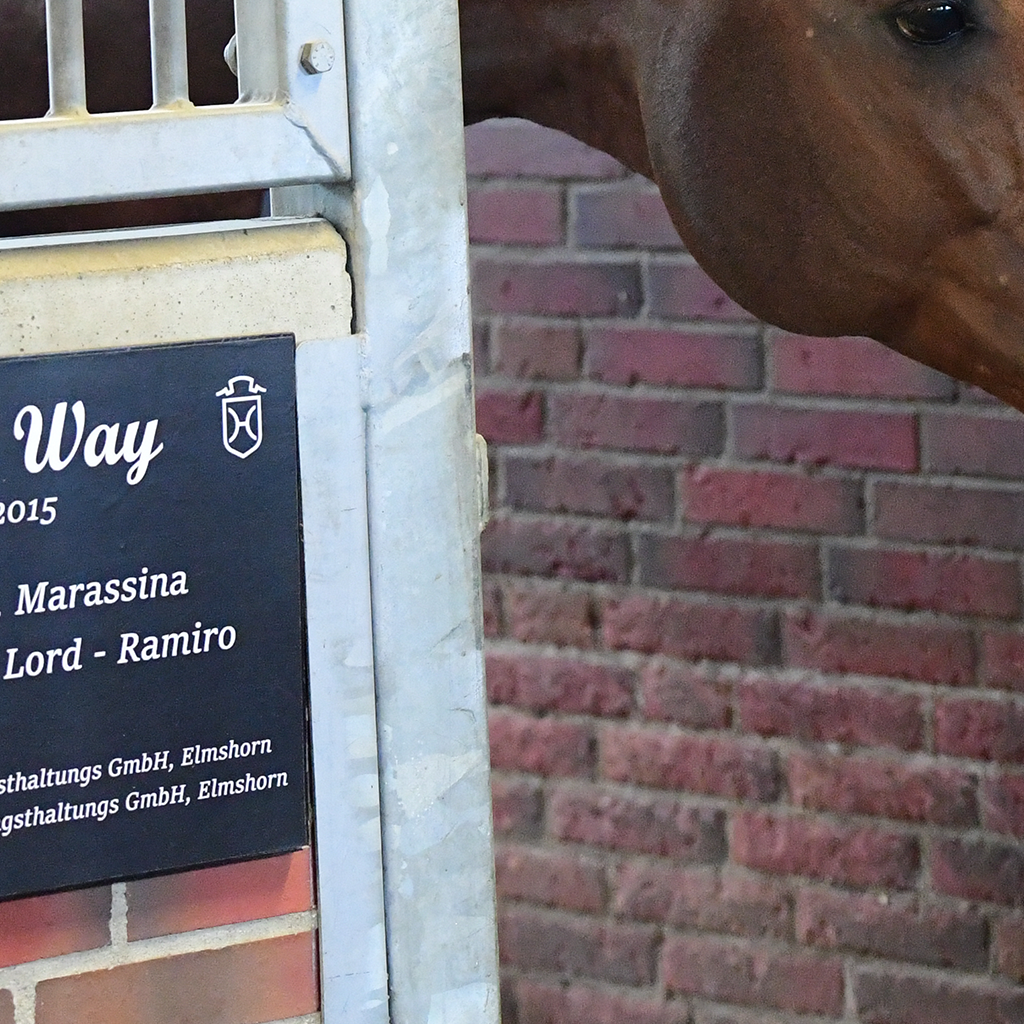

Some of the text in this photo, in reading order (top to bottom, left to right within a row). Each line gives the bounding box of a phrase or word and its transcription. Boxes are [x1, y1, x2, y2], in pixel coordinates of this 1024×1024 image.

[13, 400, 164, 485] Way
[14, 567, 189, 616] Marassina
[3, 621, 237, 680] Lord - Ramiro
[107, 750, 174, 778] GmbH,
[180, 738, 273, 767] Elmshorn
[0, 771, 289, 837] gsthaltungs GmbH, Elmshorn
